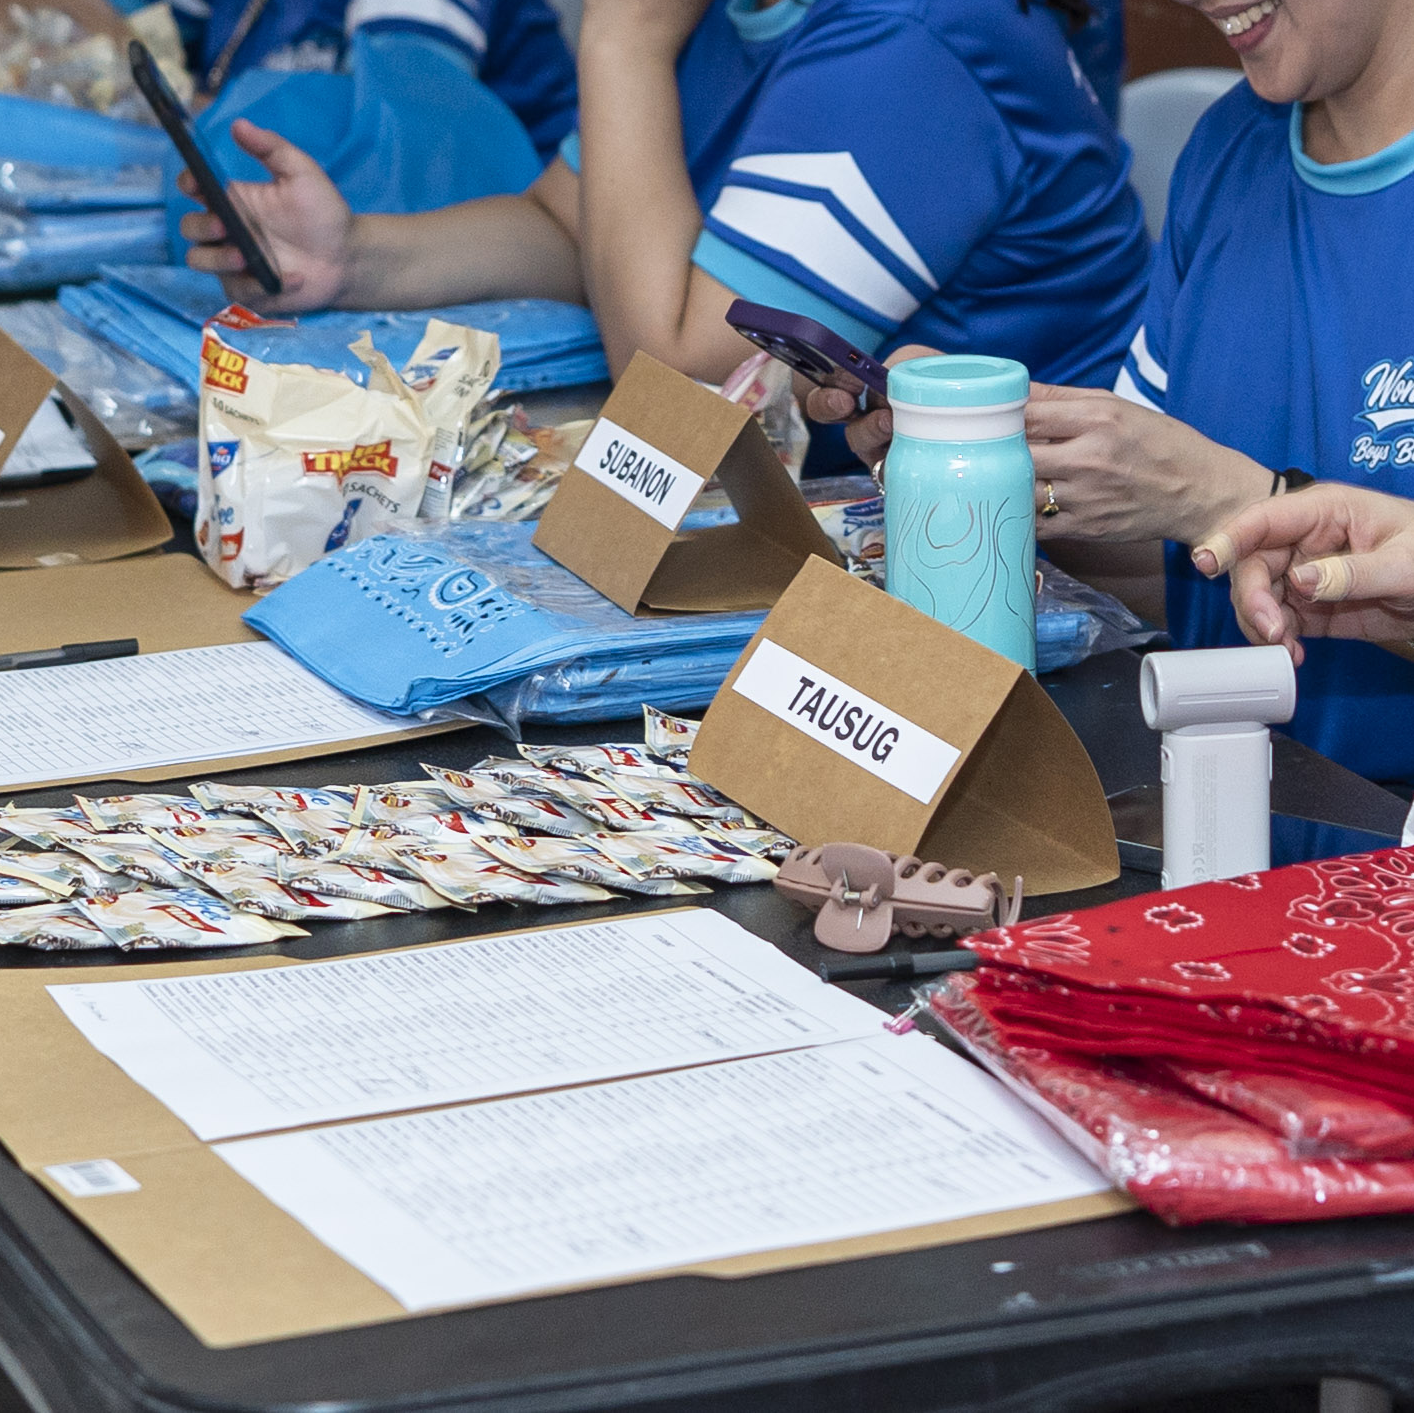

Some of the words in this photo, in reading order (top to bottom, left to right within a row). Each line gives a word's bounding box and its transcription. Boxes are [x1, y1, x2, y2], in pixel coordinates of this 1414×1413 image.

[599, 439, 677, 506] SUBANON
[1352, 436, 1390, 469] Boys
[348, 481, 402, 514] SACHETS
[787, 675, 899, 764] TAUSUG
